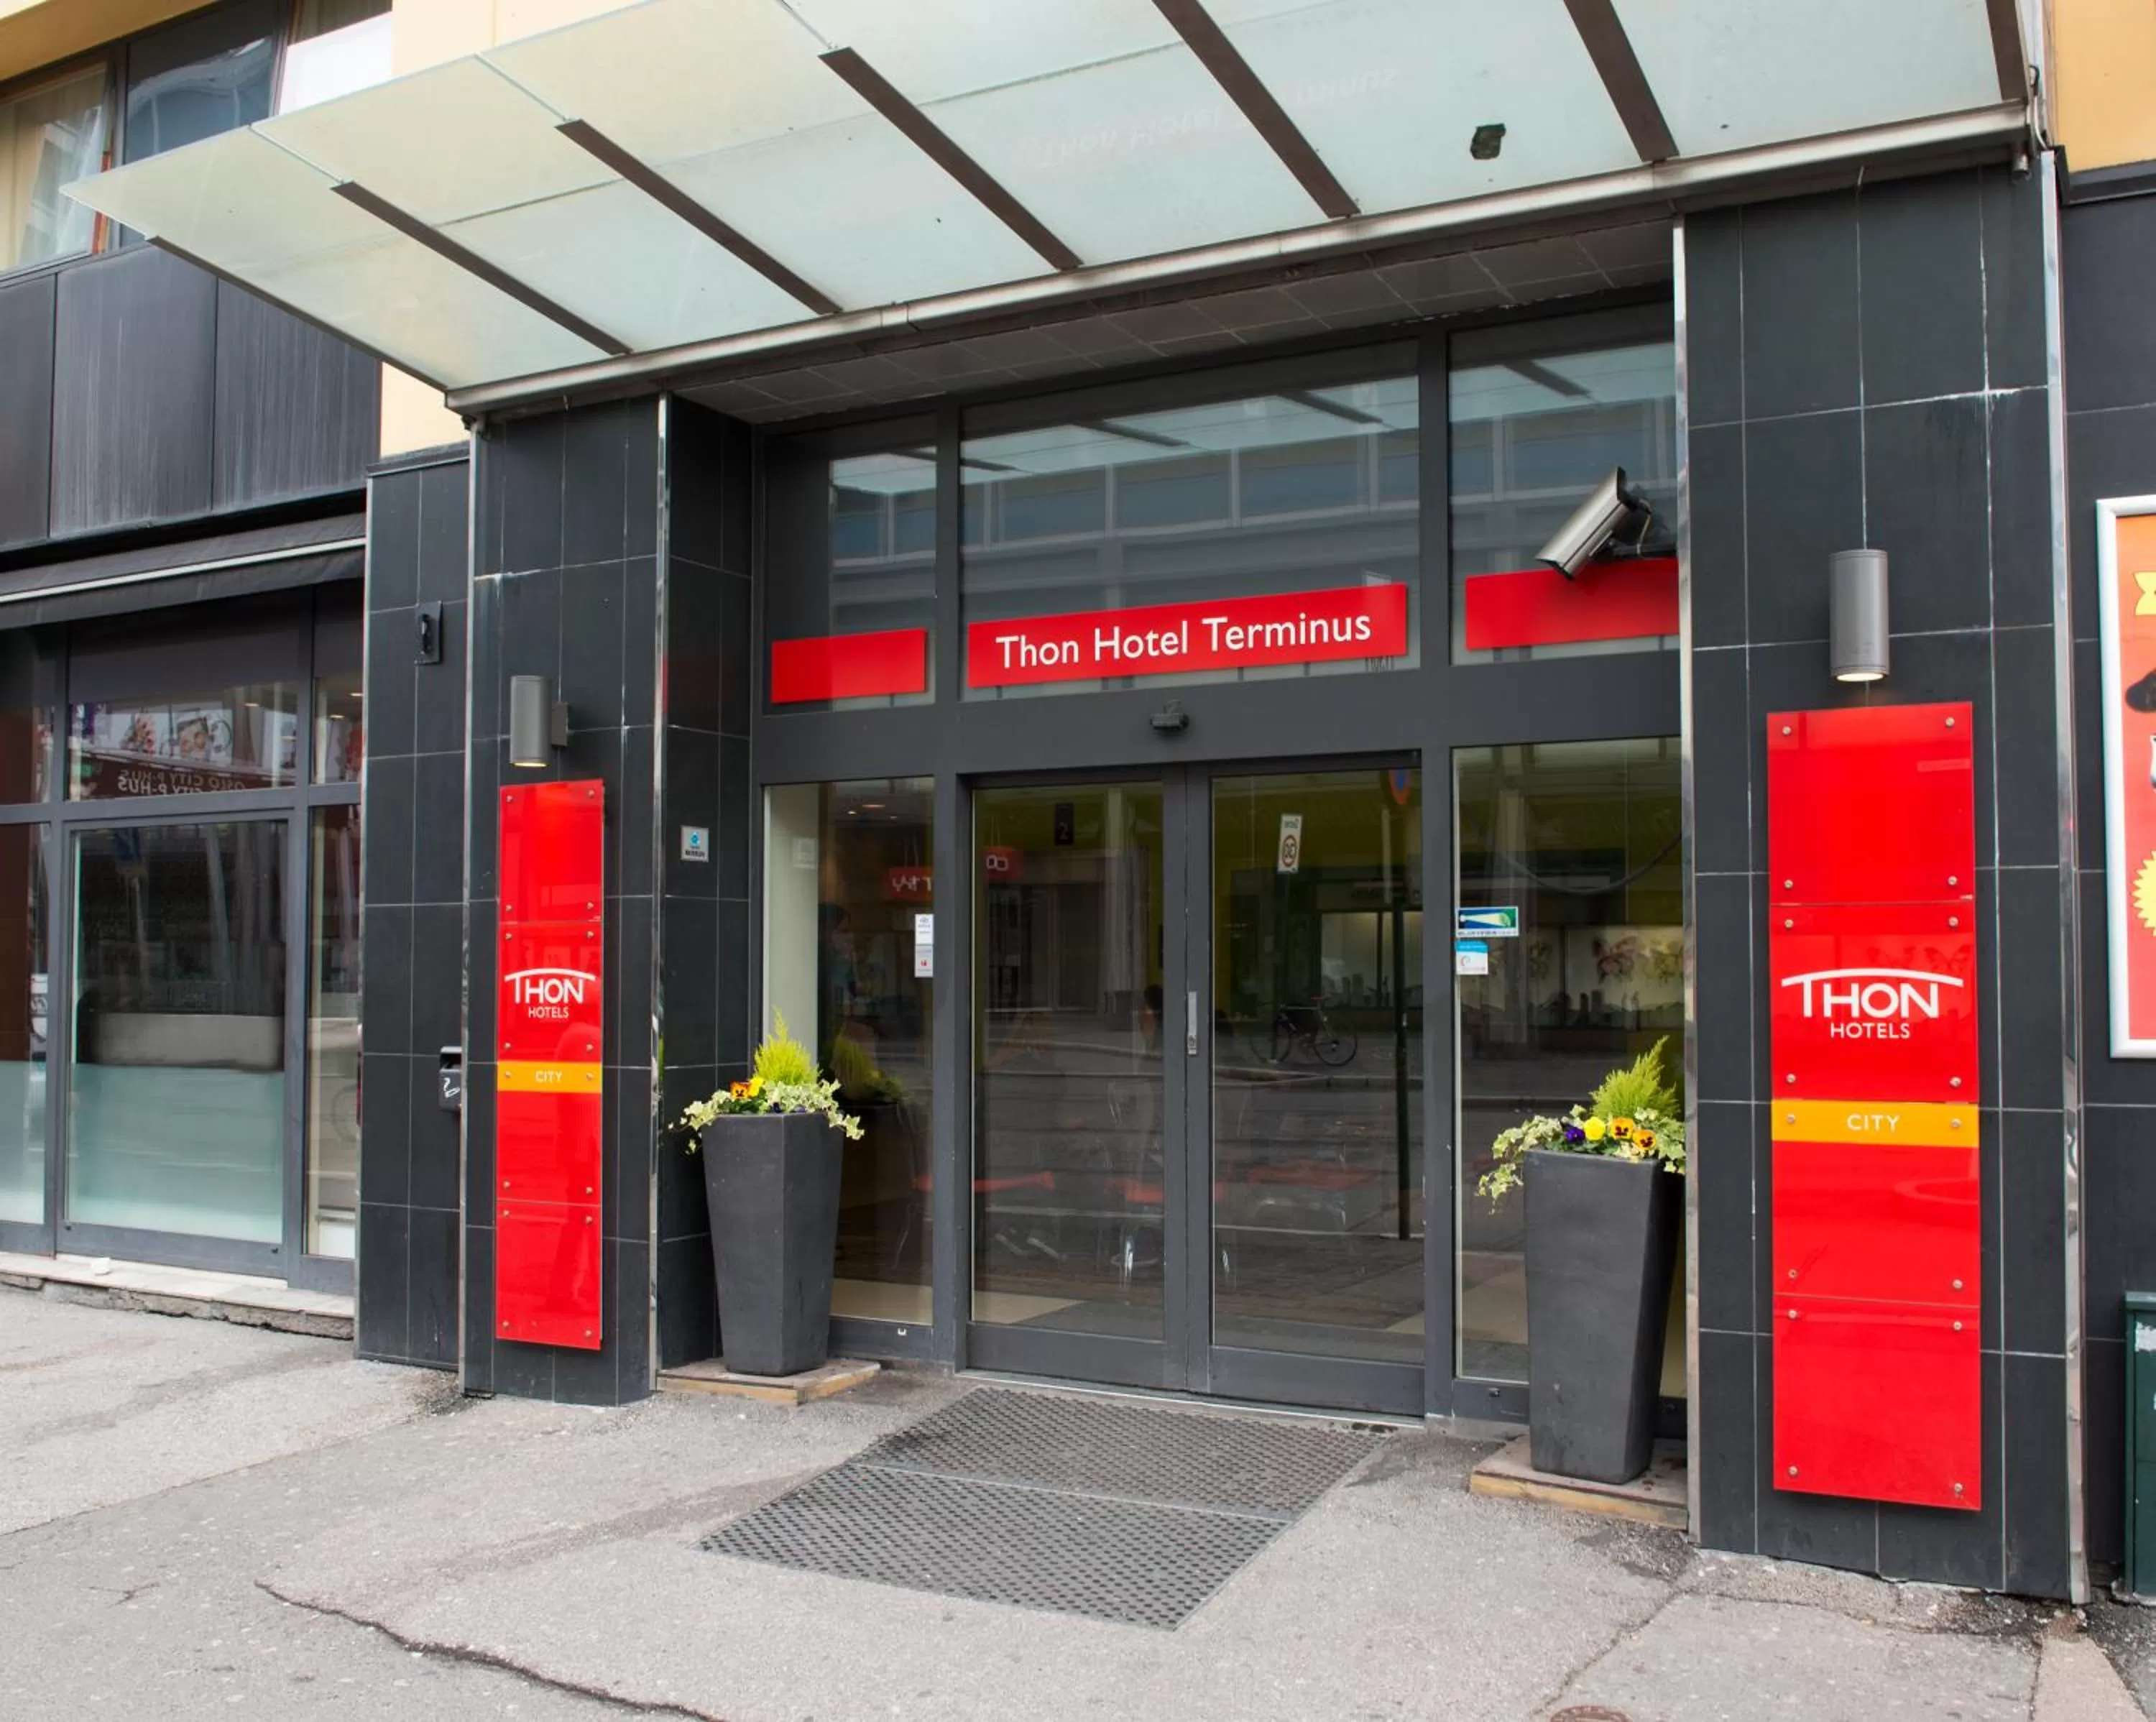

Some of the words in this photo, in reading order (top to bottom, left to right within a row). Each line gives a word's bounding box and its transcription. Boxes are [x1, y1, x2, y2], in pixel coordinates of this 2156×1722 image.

[995, 635, 1079, 668] Thon
[1094, 620, 1188, 661] Hotel
[1202, 612, 1371, 652] Terminus
[505, 968, 596, 1004] THON
[1782, 967, 1963, 1018] THON
[528, 1006, 569, 1018] HOTELS
[1830, 1023, 1910, 1039] HOTELS
[535, 1070, 563, 1083] CITY
[1847, 1115, 1900, 1132] CITY
